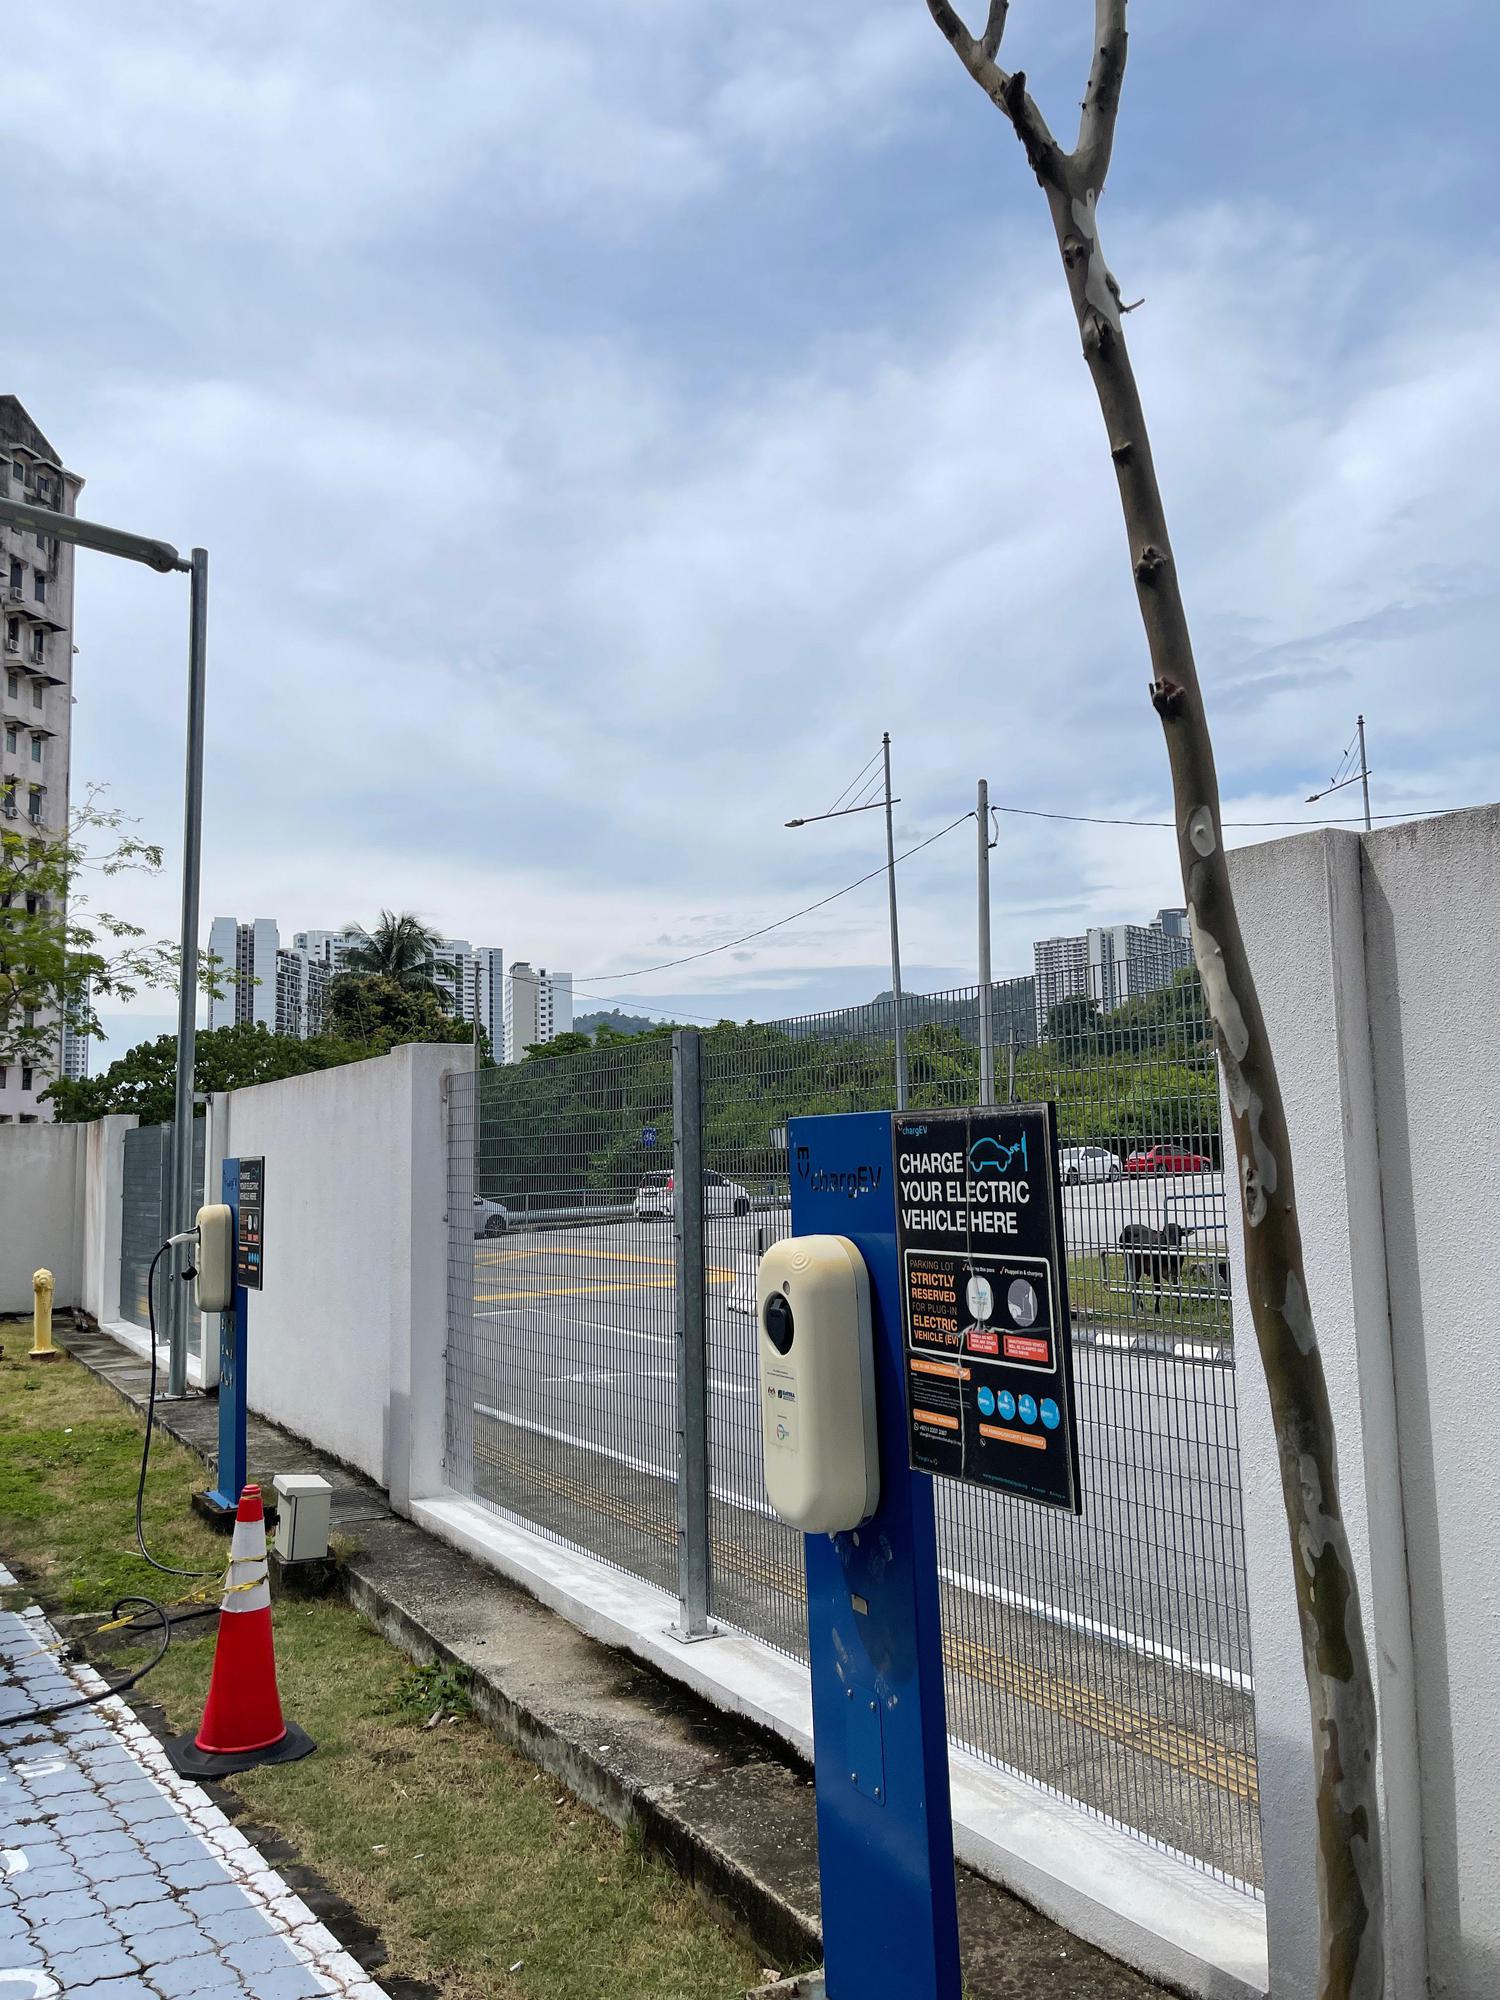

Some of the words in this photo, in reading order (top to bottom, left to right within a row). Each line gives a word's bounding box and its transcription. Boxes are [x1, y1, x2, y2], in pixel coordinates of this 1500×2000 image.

[902, 1125, 928, 1137] chargEV
[900, 1152, 964, 1174] CHARGE
[900, 1181, 943, 1202] YOUR
[946, 1181, 1030, 1203] ELECTRIC
[902, 1209, 967, 1232] VEHICLE
[970, 1211, 1018, 1234] HERE
[910, 1259, 939, 1270] PARKING
[941, 1261, 954, 1271] LOT
[911, 1272, 954, 1287] STRICTLY
[912, 1288, 956, 1302] RESERVED
[912, 1302, 926, 1311] FOR
[928, 1303, 957, 1315] PLUG-IN
[913, 1314, 958, 1331] ELECTRIC
[914, 1330, 944, 1343] VEHICLE
